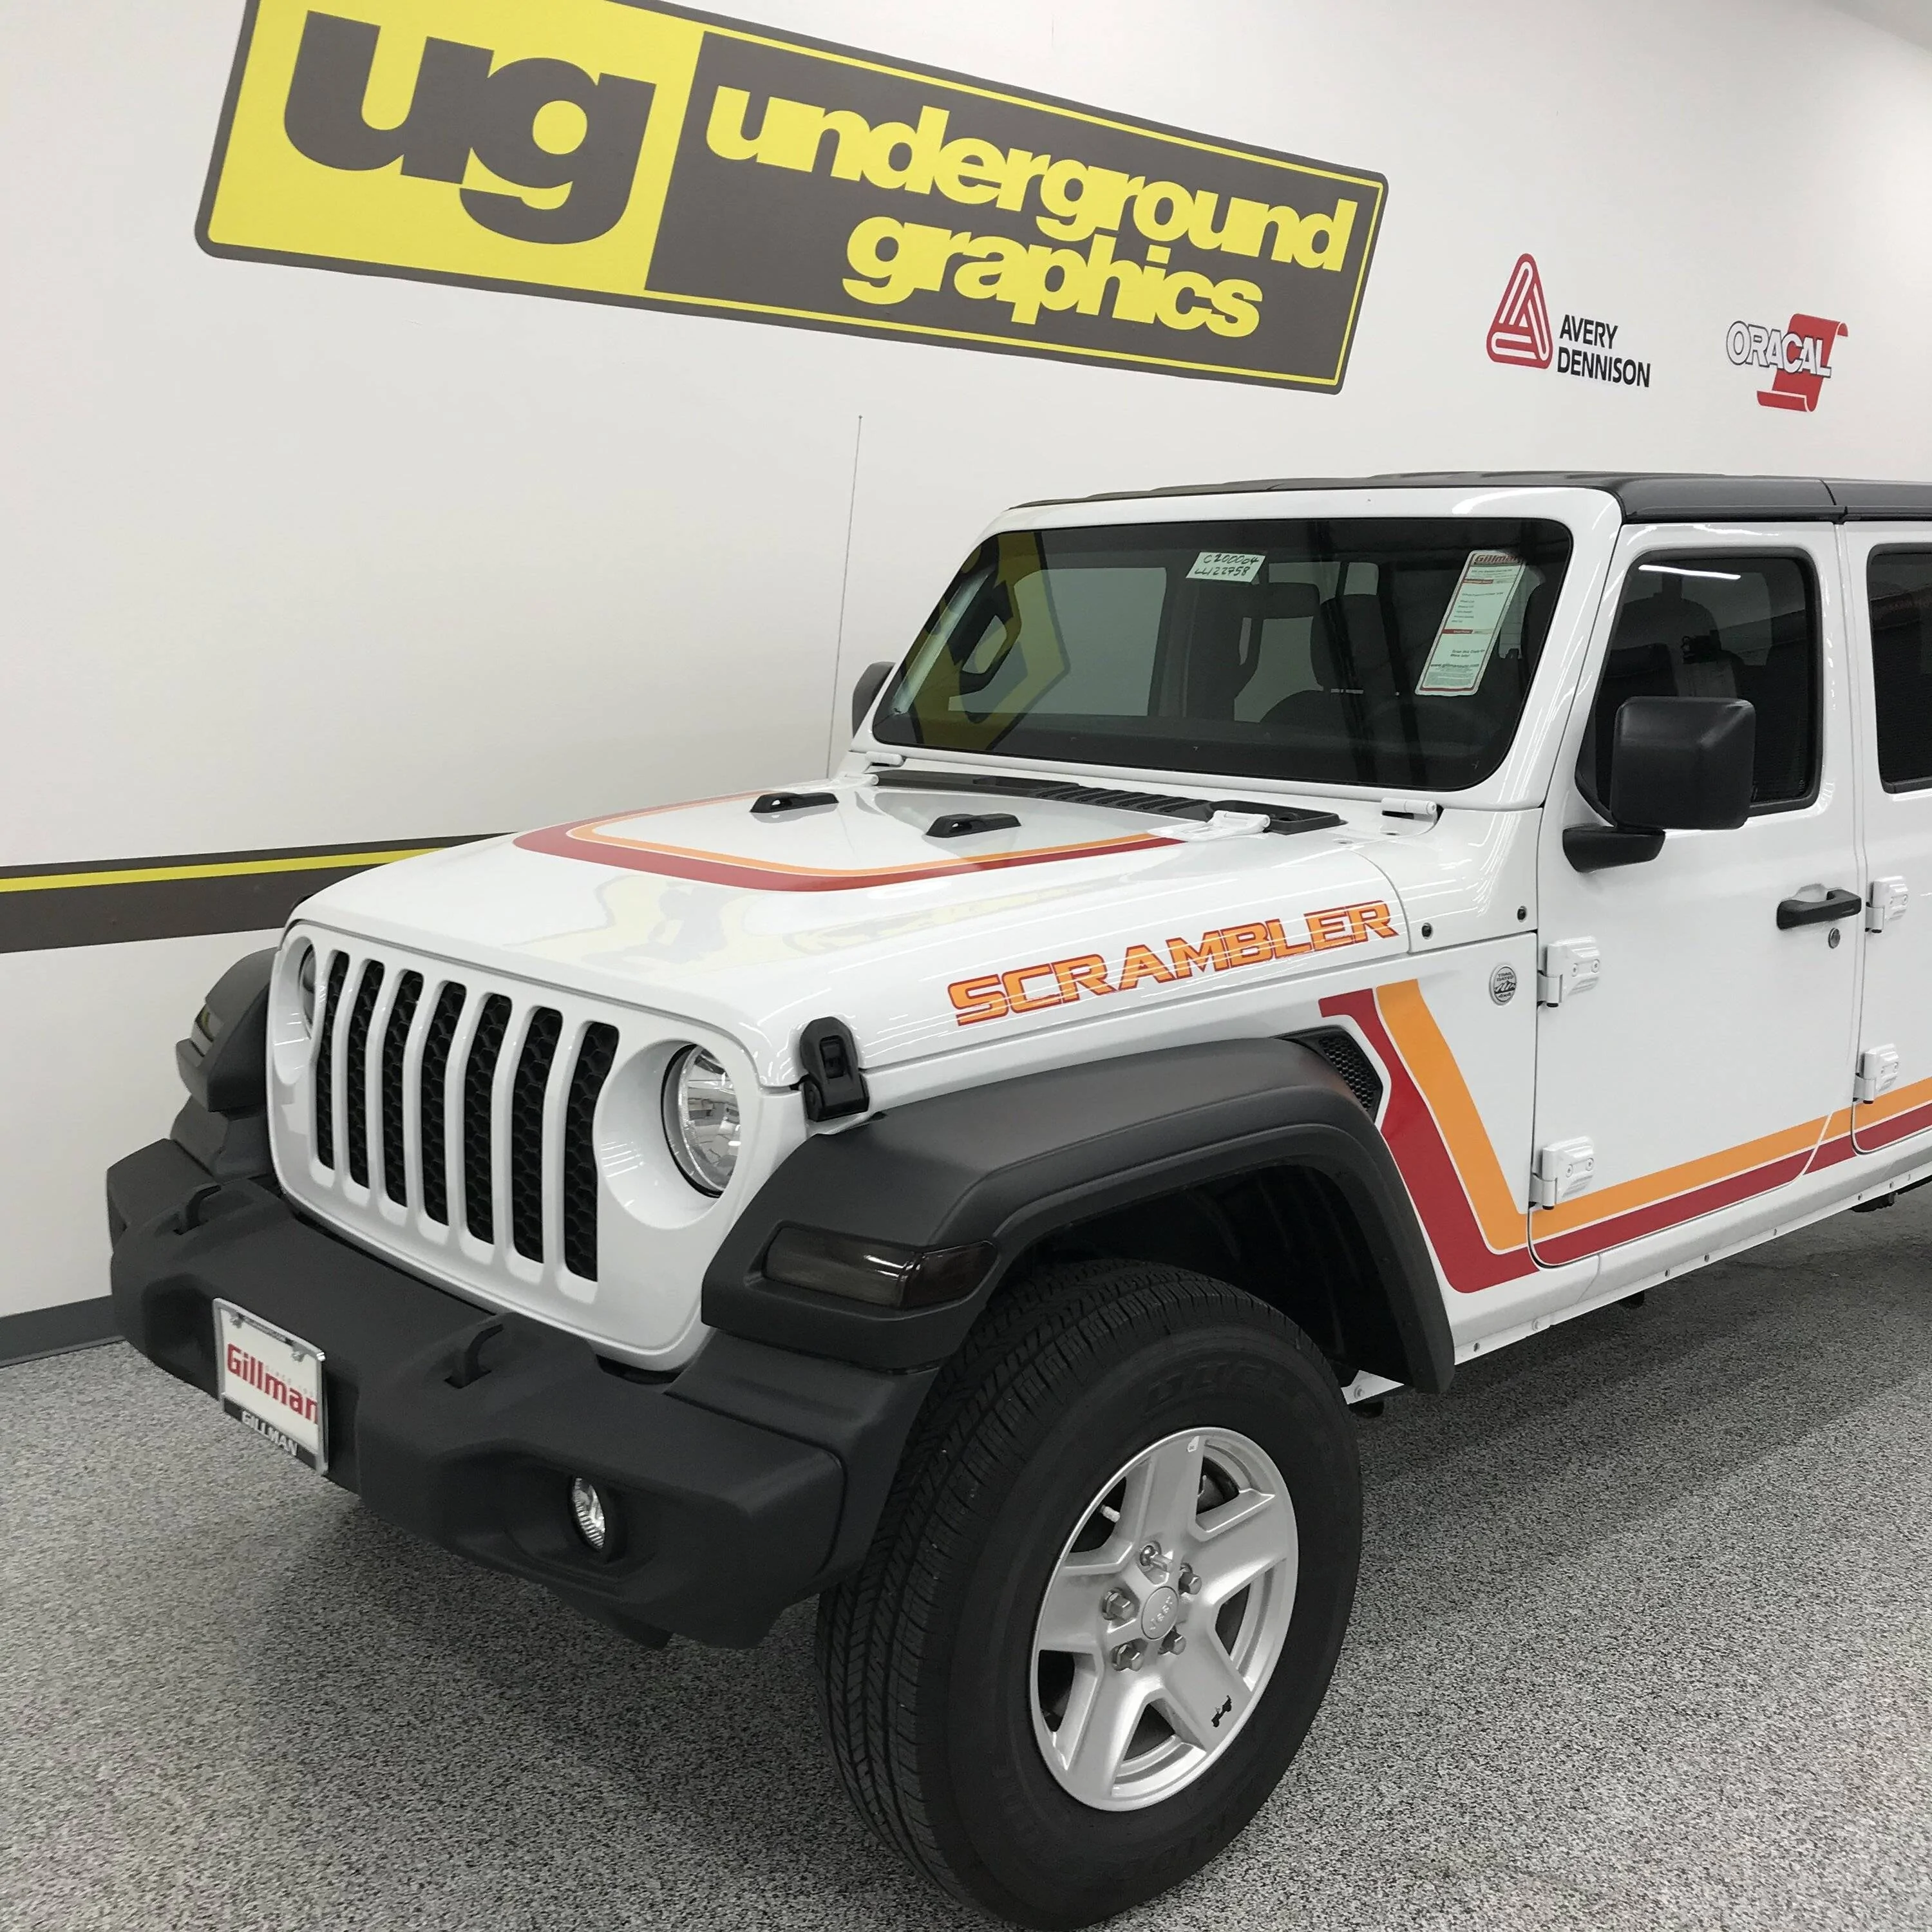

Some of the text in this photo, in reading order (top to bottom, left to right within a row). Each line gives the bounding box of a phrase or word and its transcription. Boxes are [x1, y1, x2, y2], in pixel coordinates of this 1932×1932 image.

[284, 10, 657, 245] ug
[706, 85, 1358, 272] underground
[842, 216, 1264, 337] graphics
[1557, 346, 1651, 388] DENNISON
[1559, 314, 1618, 350] AVERY
[1725, 319, 1832, 379] ORACAL
[947, 899, 1400, 1027] SCRAMBLER
[227, 1343, 318, 1425] Gillman
